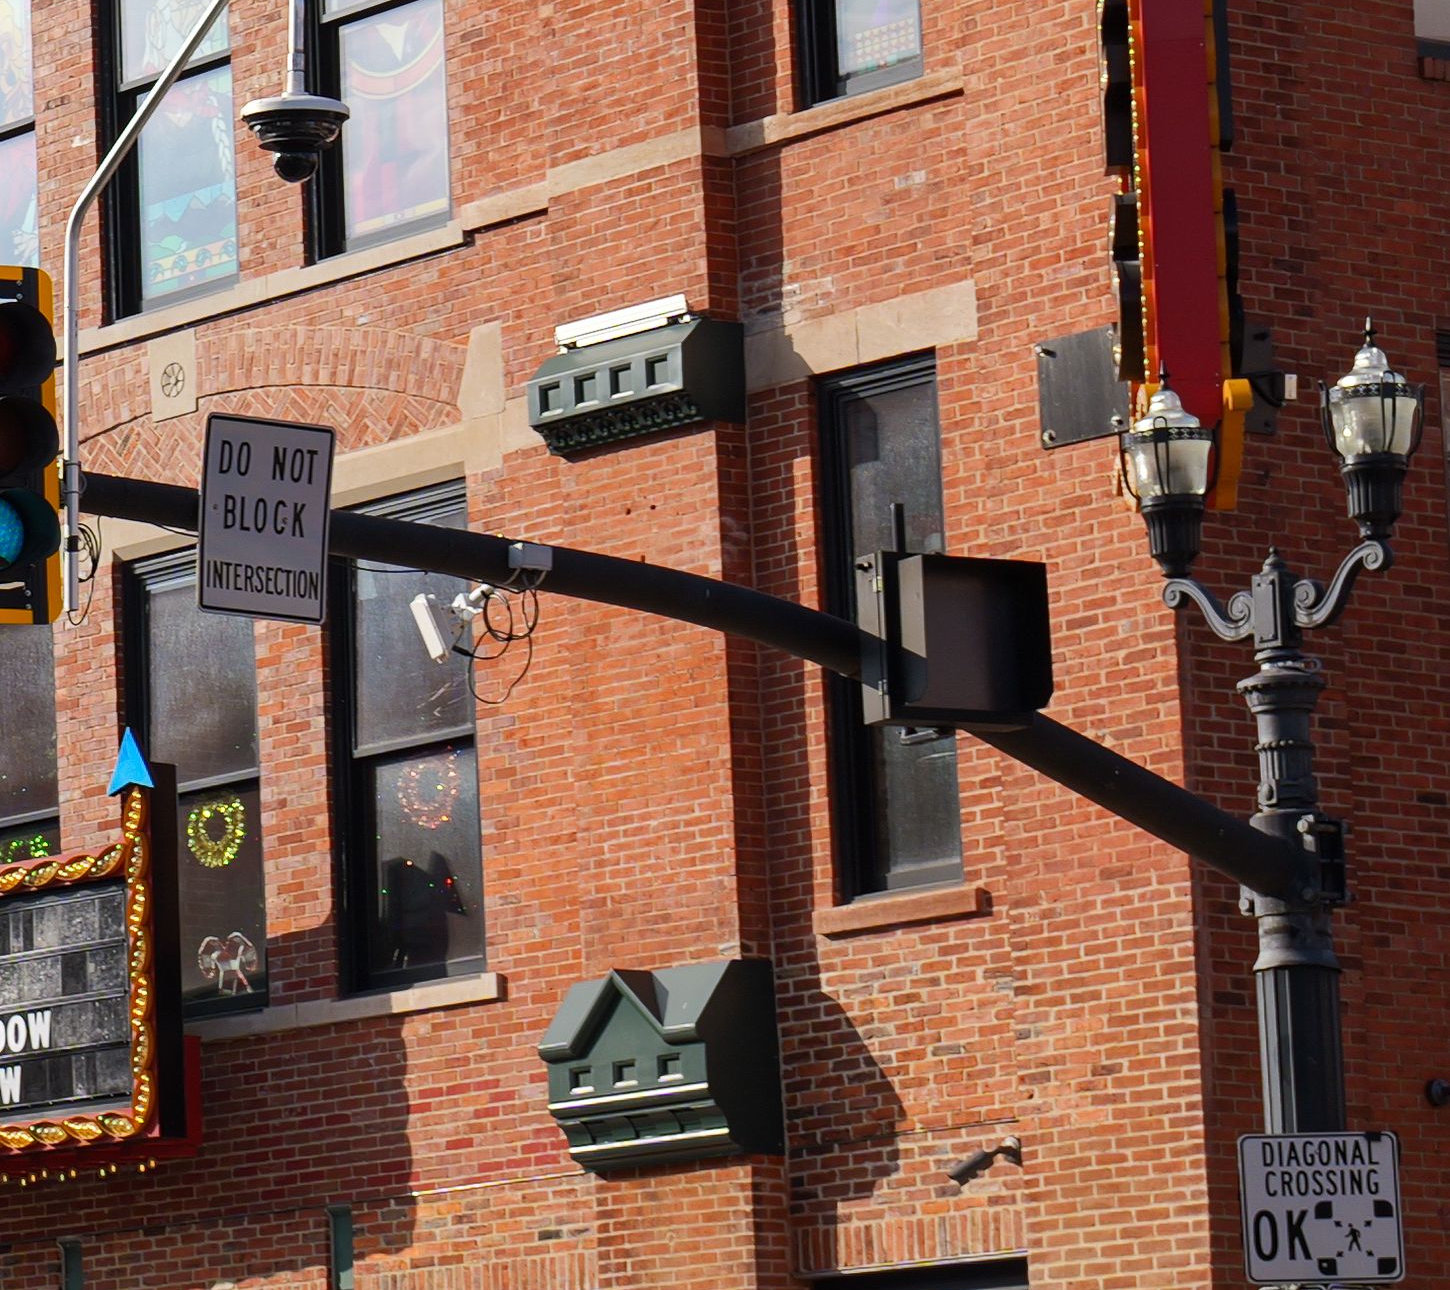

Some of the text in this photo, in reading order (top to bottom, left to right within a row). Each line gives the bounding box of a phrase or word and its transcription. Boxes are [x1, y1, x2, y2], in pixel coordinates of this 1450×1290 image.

[218, 440, 319, 485] DO NOT
[223, 494, 306, 538] BLOCK
[206, 560, 319, 601] INTERSECTION
[1261, 1140, 1380, 1168] DIAGONAL
[1265, 1169, 1380, 1198] CROSSING
[1252, 1209, 1313, 1263] OK
